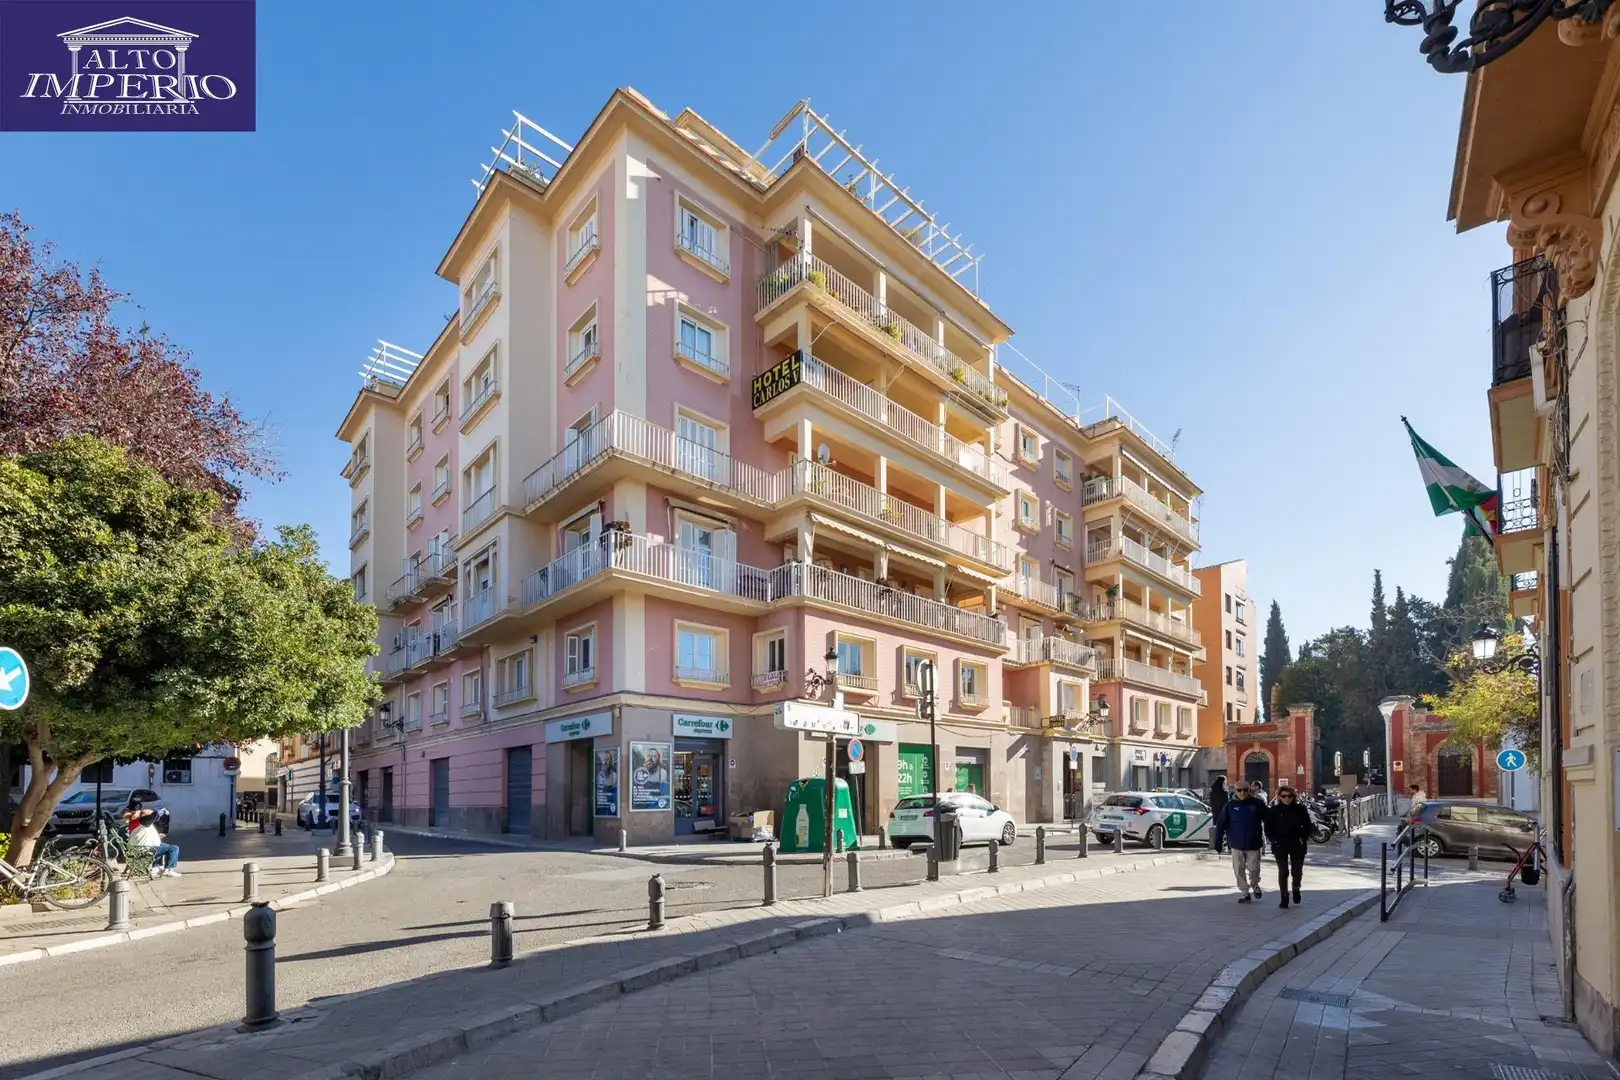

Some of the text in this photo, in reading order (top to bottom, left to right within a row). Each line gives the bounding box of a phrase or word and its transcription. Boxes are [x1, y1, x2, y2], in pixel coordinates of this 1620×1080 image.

[753, 355, 800, 394] HOTEL
[753, 374, 791, 407] CARLOS
[678, 718, 713, 728] Carrefour
